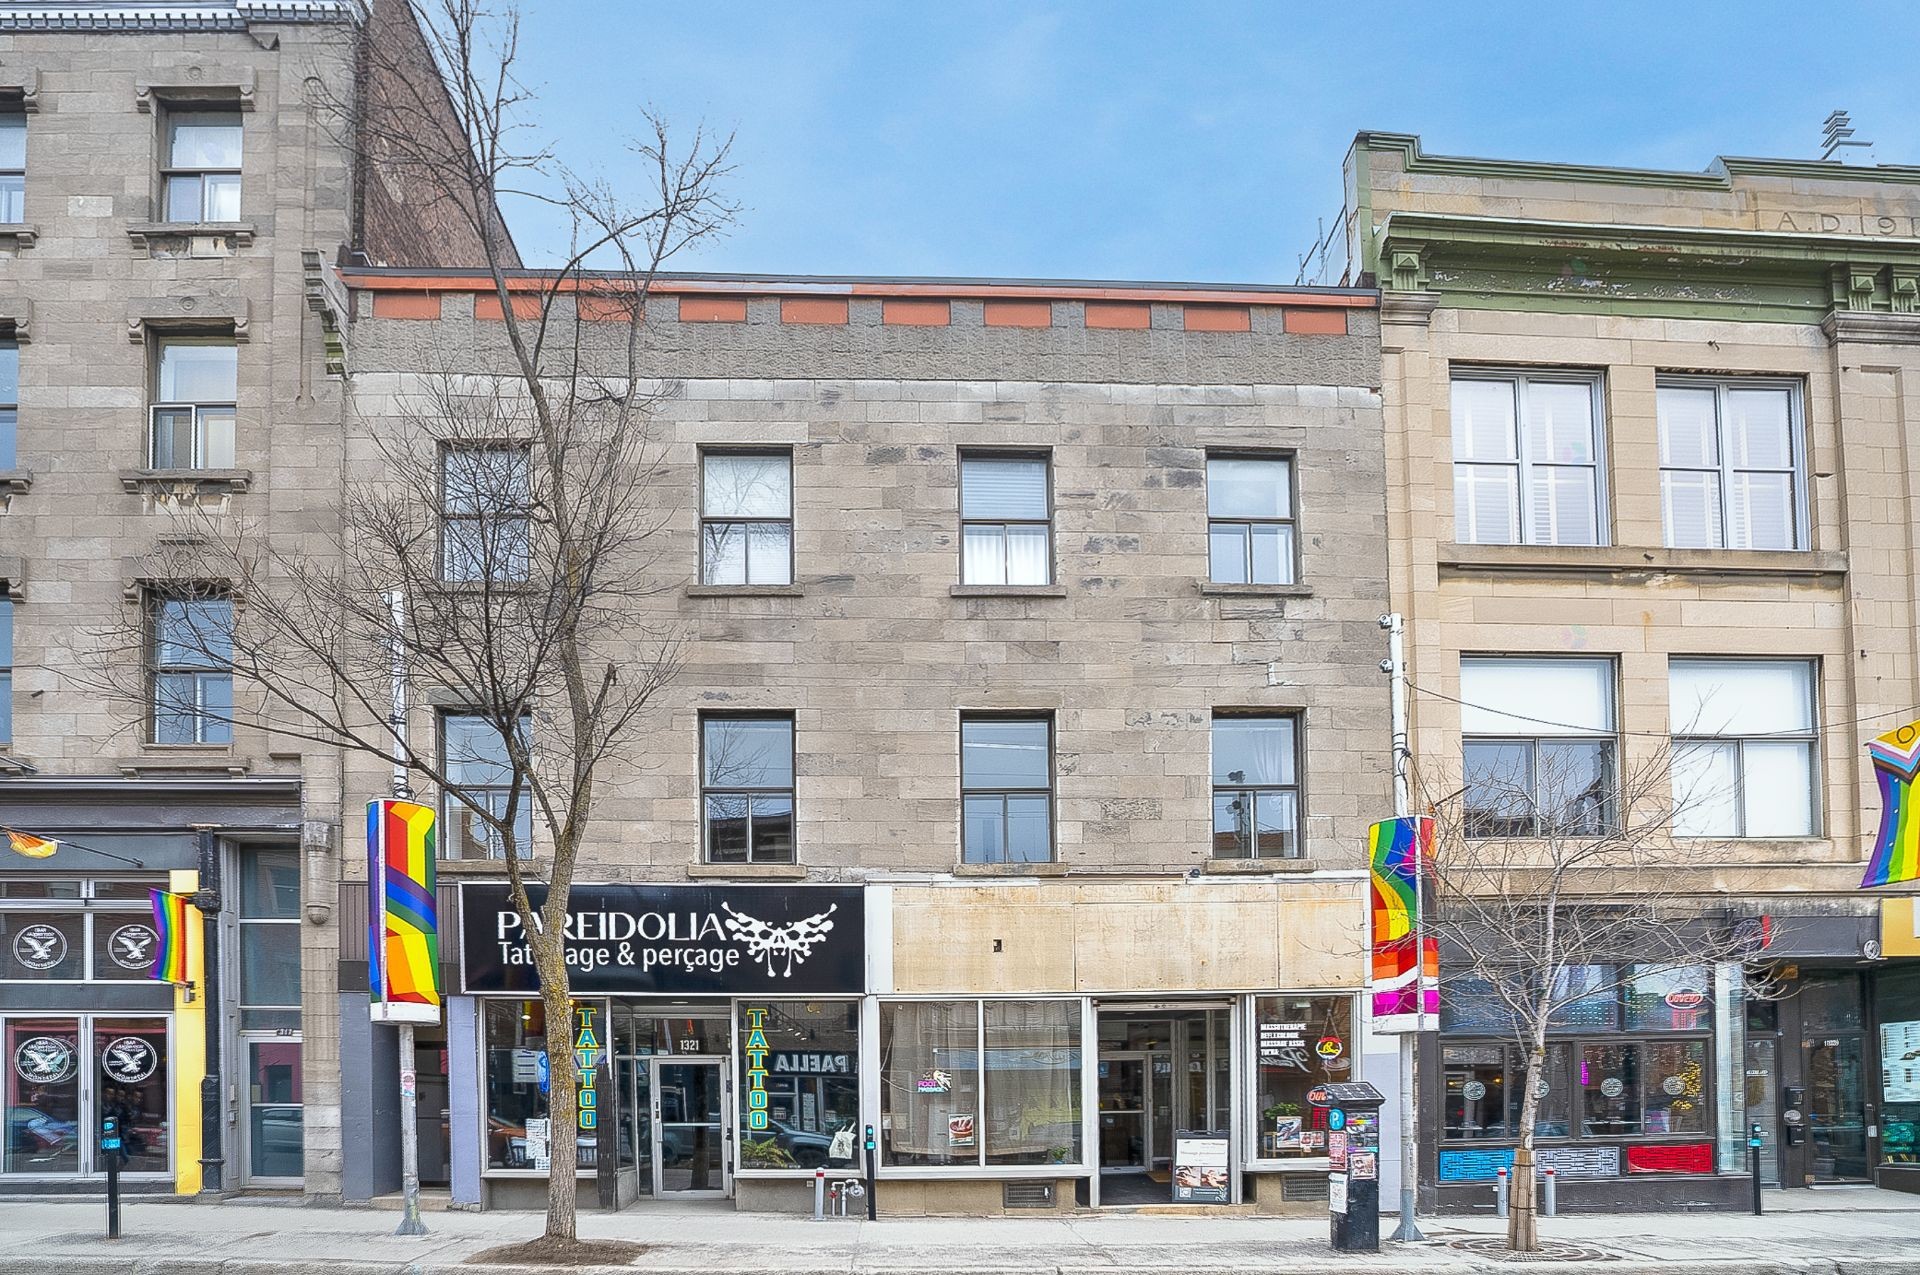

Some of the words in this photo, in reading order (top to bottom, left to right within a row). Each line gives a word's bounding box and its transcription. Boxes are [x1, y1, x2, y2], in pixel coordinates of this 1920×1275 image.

[498, 911, 727, 941] PREIDOLIA
[498, 941, 610, 973] Tatage
[617, 941, 636, 966] &
[643, 946, 740, 973] perçage
[679, 1040, 699, 1050] 1321
[576, 1008, 599, 1129] TATTOO
[746, 1009, 770, 1130] TATTOO
